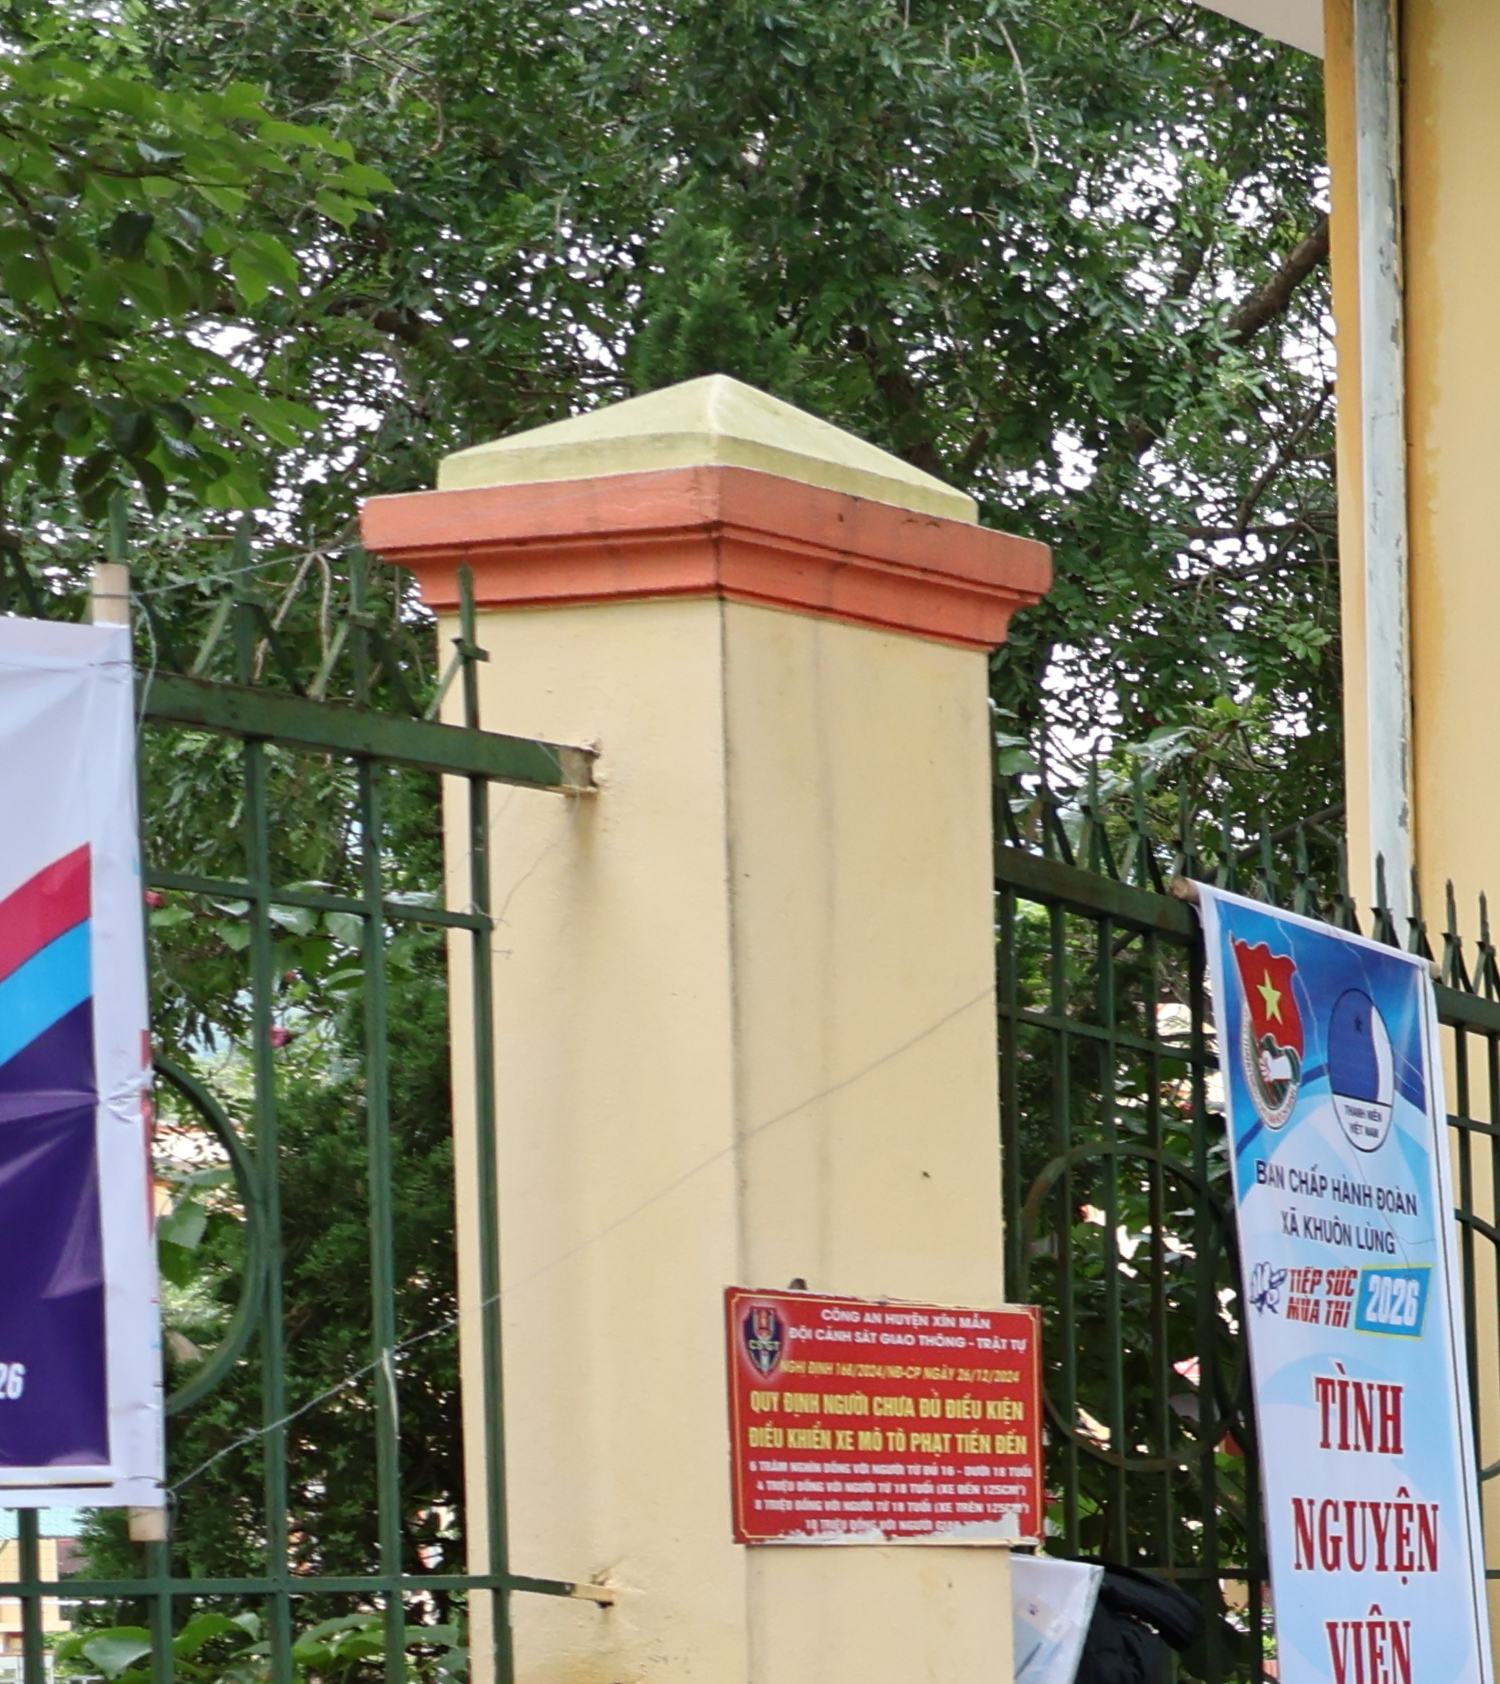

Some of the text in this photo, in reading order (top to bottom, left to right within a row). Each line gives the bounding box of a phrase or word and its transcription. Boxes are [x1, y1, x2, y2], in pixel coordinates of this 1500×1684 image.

[1256, 1160, 1418, 1216] BAN CHẤP HÀNH ĐOÀN
[1281, 1207, 1396, 1254] XÃ KHUÔN LÙNG
[1289, 1266, 1358, 1297] TIẾP SỨC
[821, 1308, 859, 1323] CÔNG
[863, 1311, 882, 1324] AN
[885, 1310, 929, 1329] HUYỆN
[932, 1311, 956, 1329] XÍN
[1286, 1295, 1351, 1328] MÙA THI
[1365, 1275, 1420, 1327] 2026
[788, 1325, 1027, 1352] ĐỘI CẢNH SÁT GIAO THÔNG TRẬT TỰ
[750, 1387, 1024, 1424] QUY ĐỊNH NGƯỜI CHƯA ĐỦ ĐIỀU KIỆN
[1315, 1362, 1404, 1455] TÌNH
[748, 1420, 1028, 1458] ĐIỀU KHIỂN XE MÔ TÔ PHẠT TIỀN ĐẾN
[1292, 1486, 1439, 1586] NGUYỆN
